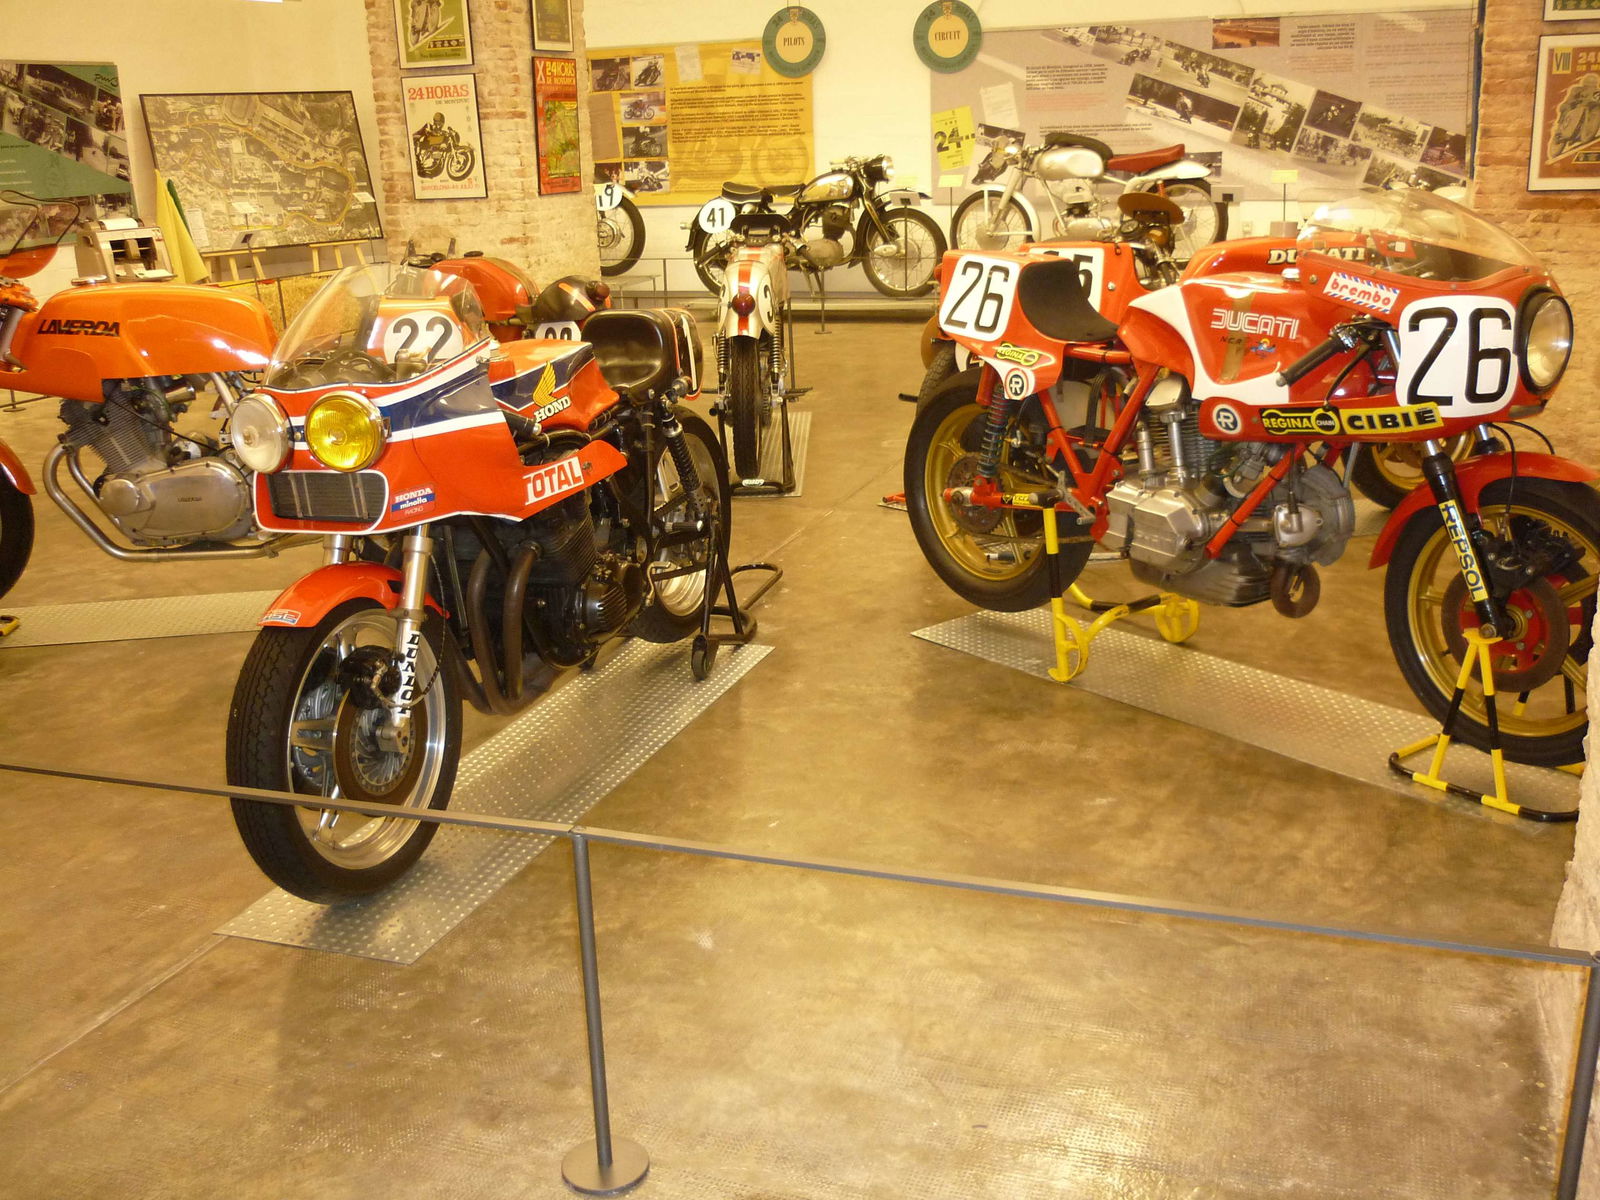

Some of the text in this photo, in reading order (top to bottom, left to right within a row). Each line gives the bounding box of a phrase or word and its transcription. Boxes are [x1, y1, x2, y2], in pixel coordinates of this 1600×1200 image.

[783, 36, 805, 46] PILOTS
[934, 30, 961, 41] CIRCUIT
[536, 60, 546, 83] X
[545, 61, 556, 75] 24
[408, 84, 470, 100] 24 HORAS
[934, 127, 964, 153] 24
[707, 207, 725, 228] 41
[1267, 247, 1365, 265] DUATI
[944, 260, 1010, 334] 26
[1331, 278, 1391, 306] brembo
[37, 320, 120, 337] LAVERDA
[1210, 308, 1299, 339] DUCATI
[393, 316, 453, 365] 22
[1407, 306, 1512, 407] 26
[533, 396, 571, 424] HOND
[1264, 417, 1335, 429] REGINA CHAIN
[523, 458, 583, 503] TOTAL
[395, 487, 433, 503] HONDA
[400, 496, 428, 510] minolta
[1443, 503, 1484, 601] REPSOL
